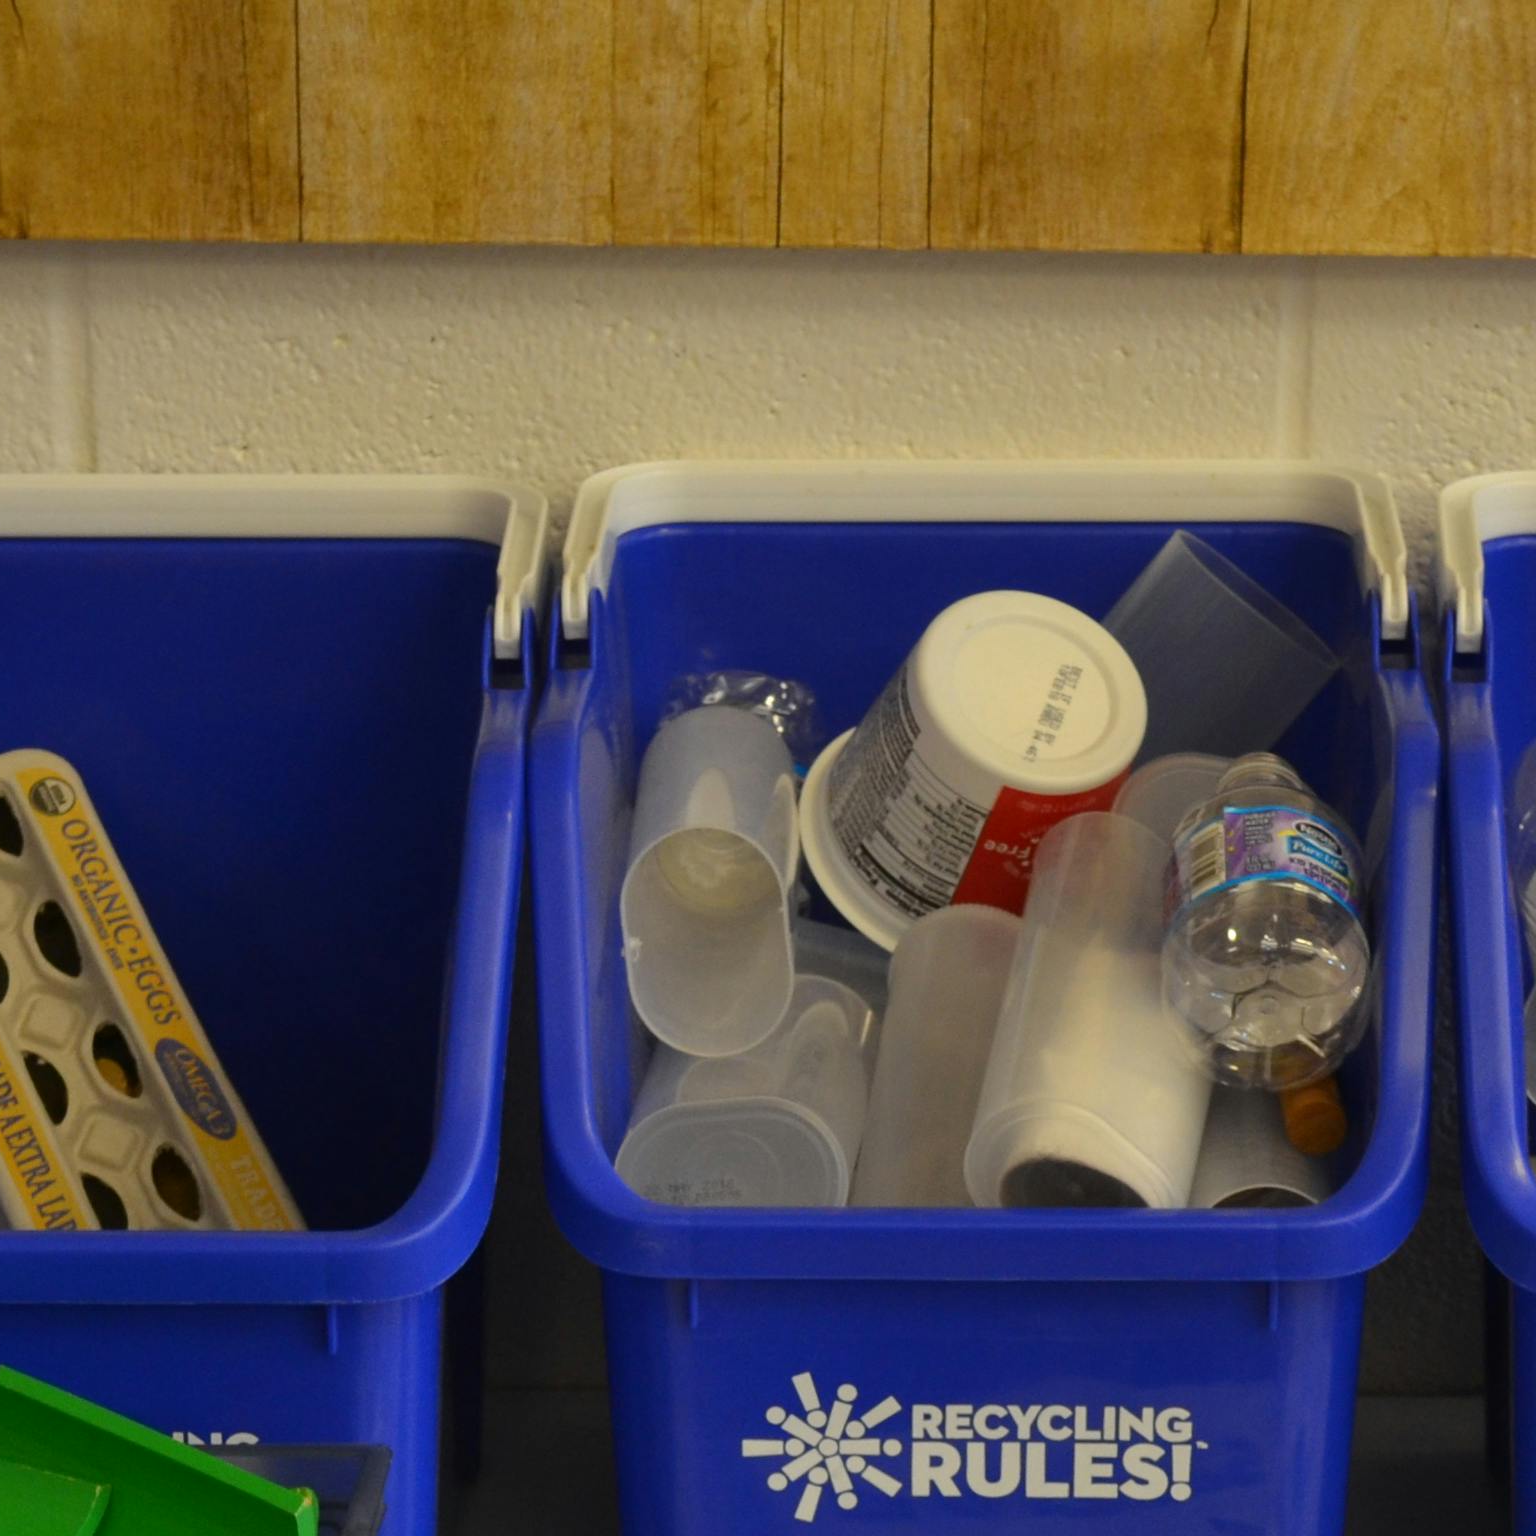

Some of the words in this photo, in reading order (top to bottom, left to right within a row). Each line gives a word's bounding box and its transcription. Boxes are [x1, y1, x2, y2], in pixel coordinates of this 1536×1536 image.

[984, 840, 1031, 859] Free
[62, 819, 143, 945] ORGANIC
[127, 953, 181, 1026] EGGS
[175, 1049, 222, 1119] OMEGA
[5, 1126, 55, 1198] EXTRA
[912, 1403, 1193, 1443] RECYCLING
[911, 1441, 1192, 1501] RULES!
